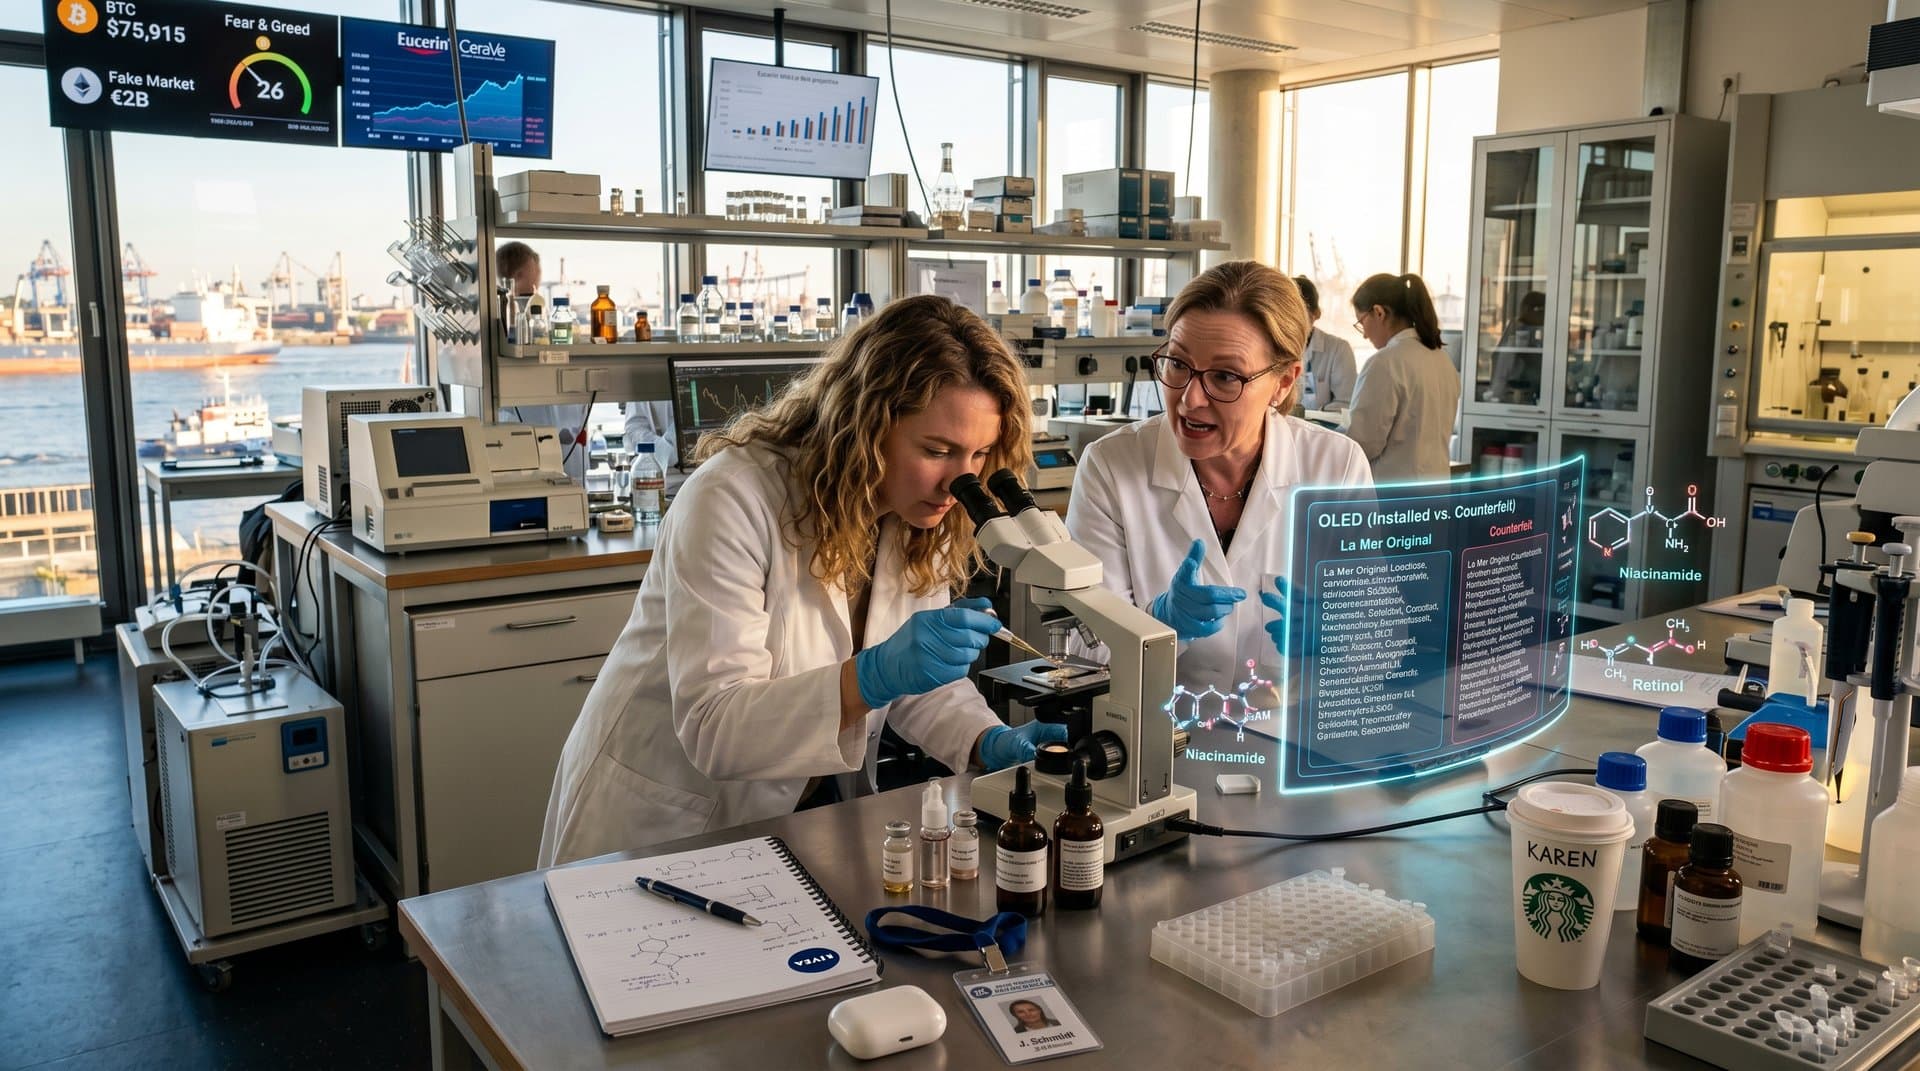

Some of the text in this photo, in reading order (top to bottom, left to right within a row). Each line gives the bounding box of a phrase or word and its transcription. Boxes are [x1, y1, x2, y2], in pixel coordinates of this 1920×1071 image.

[106, 0, 136, 16] BTC
[107, 16, 186, 43] $75,915
[225, 14, 310, 36] Fear & Greed
[398, 31, 448, 50] Eucerin
[459, 39, 506, 57] CeraVe
[108, 70, 195, 91] Fake Market
[110, 88, 150, 108] €2B
[257, 80, 284, 100] 26
[1318, 513, 1363, 528] OLED
[1367, 508, 1430, 529] (Installed
[1433, 510, 1451, 521] vs.
[1706, 517, 1726, 528] OH
[1340, 533, 1432, 552] La Mer Original
[1323, 567, 1335, 577] La
[1337, 567, 1354, 576] Mer
[1356, 564, 1388, 576] Original
[1619, 567, 1702, 582] Niacinamide
[1697, 640, 1706, 650] H
[1632, 678, 1684, 693] Retinol
[1185, 748, 1266, 765] Niacinamide
[1527, 840, 1598, 868] KAREN
[1019, 1040, 1029, 1048] J.
[1031, 1031, 1076, 1046] Schmidt
